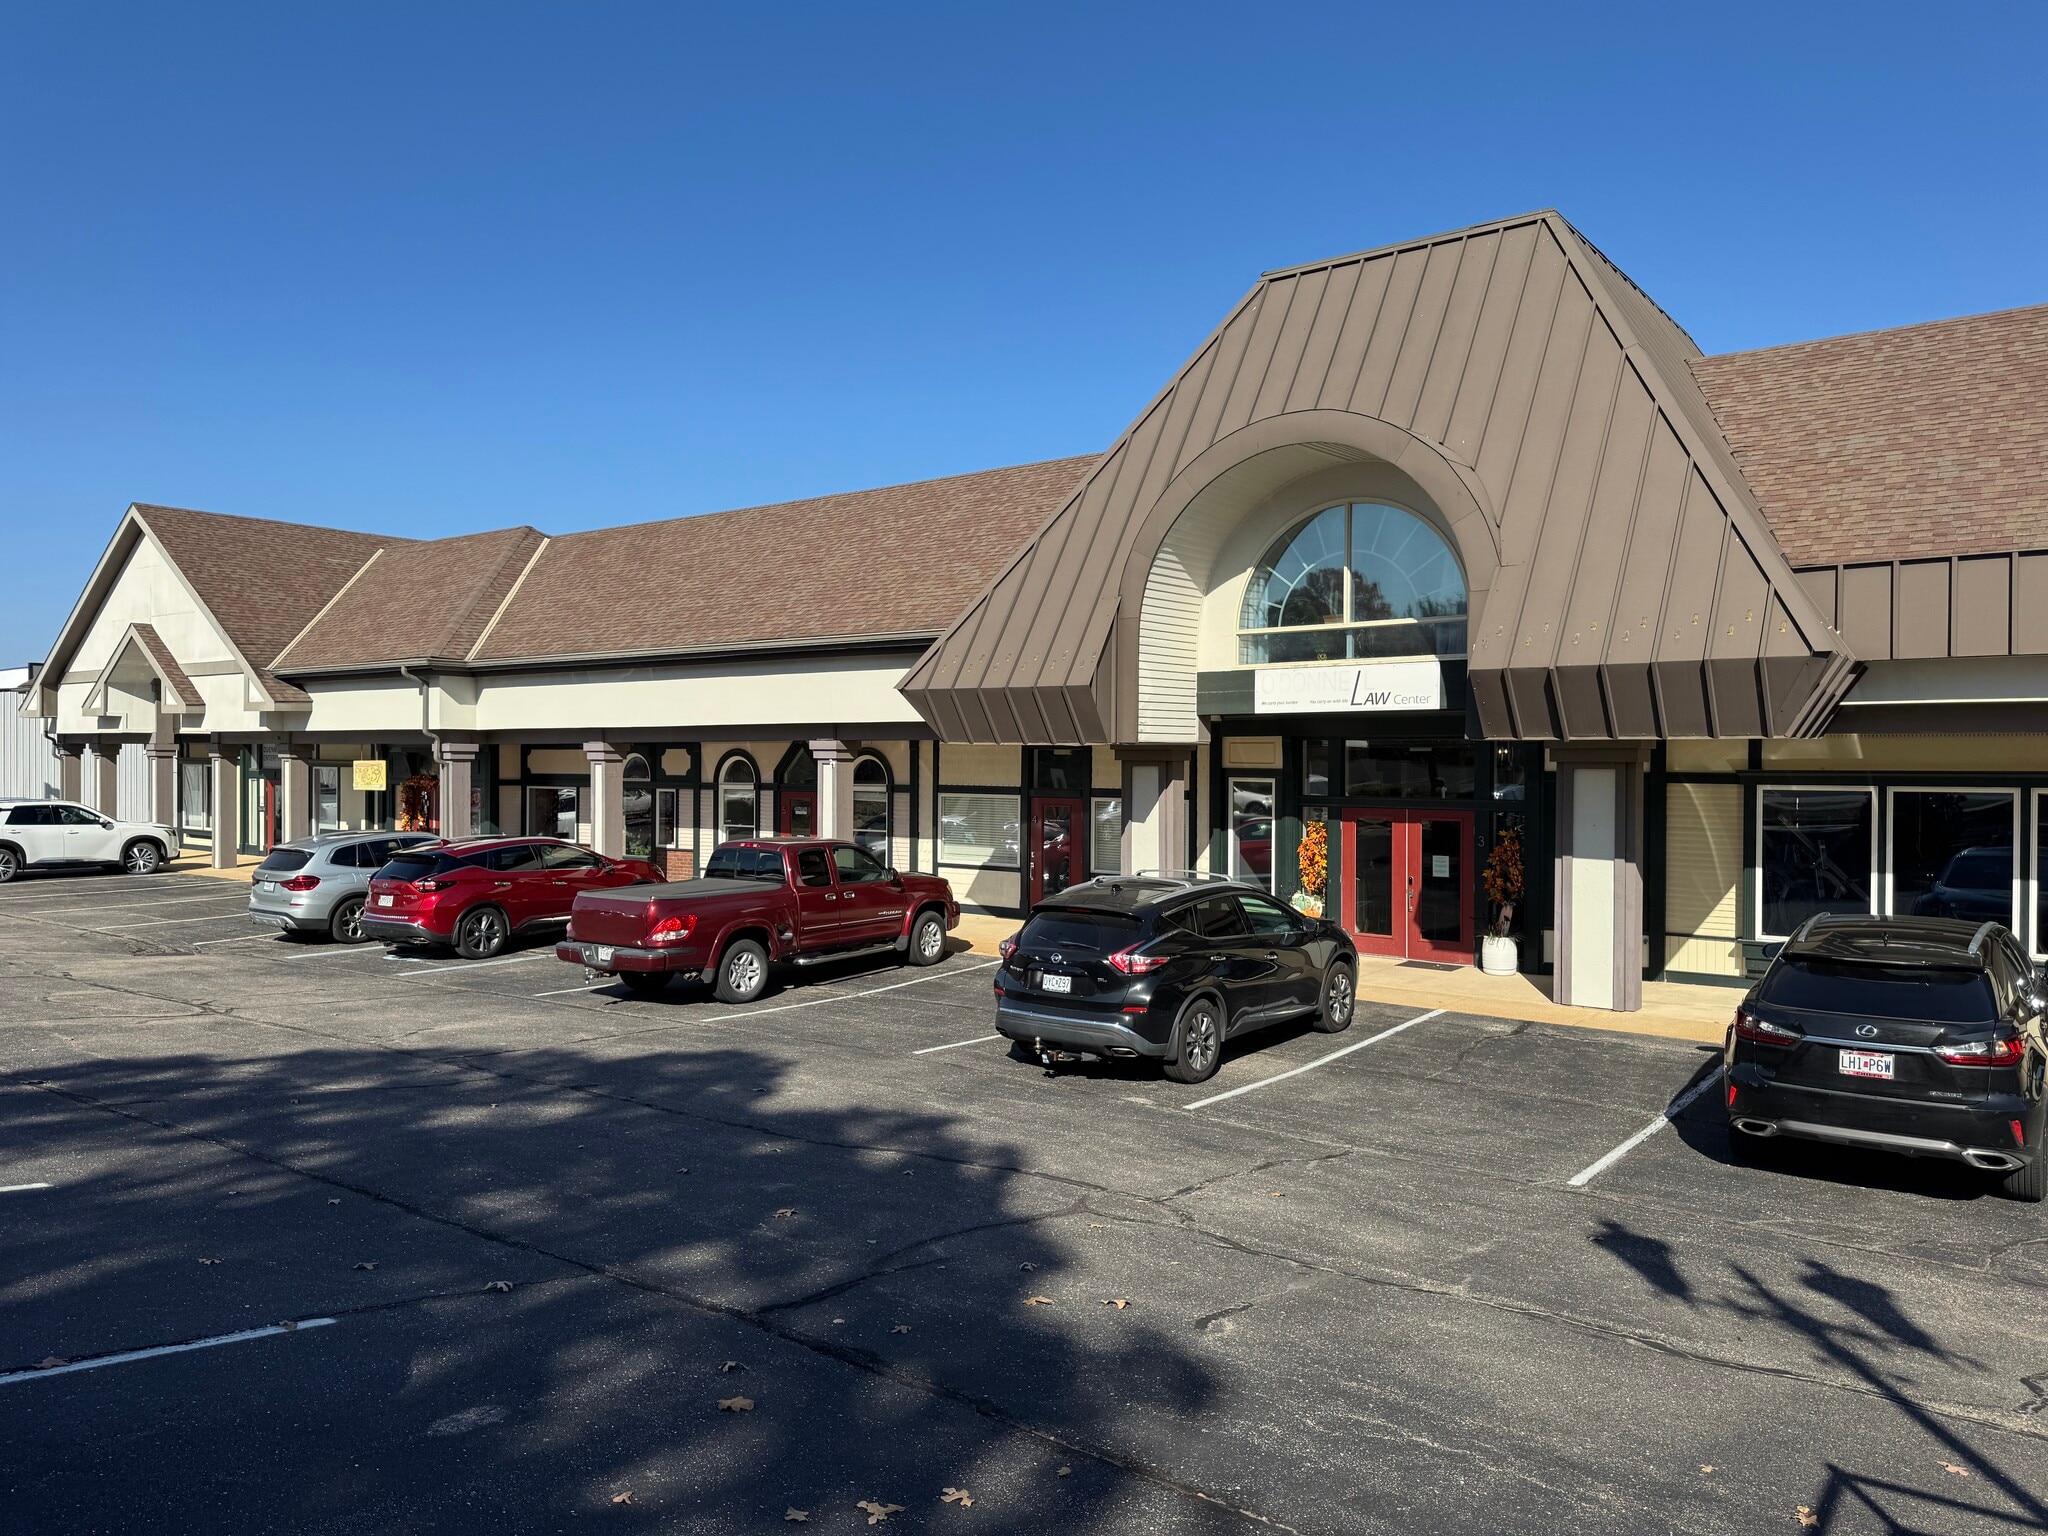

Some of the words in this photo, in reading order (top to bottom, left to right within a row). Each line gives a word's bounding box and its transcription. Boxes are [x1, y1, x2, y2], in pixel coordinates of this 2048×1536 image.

[1350, 670, 1392, 706] LAW
[1393, 694, 1432, 705] Center
[1031, 815, 1037, 824] 4
[1477, 835, 1485, 848] 3
